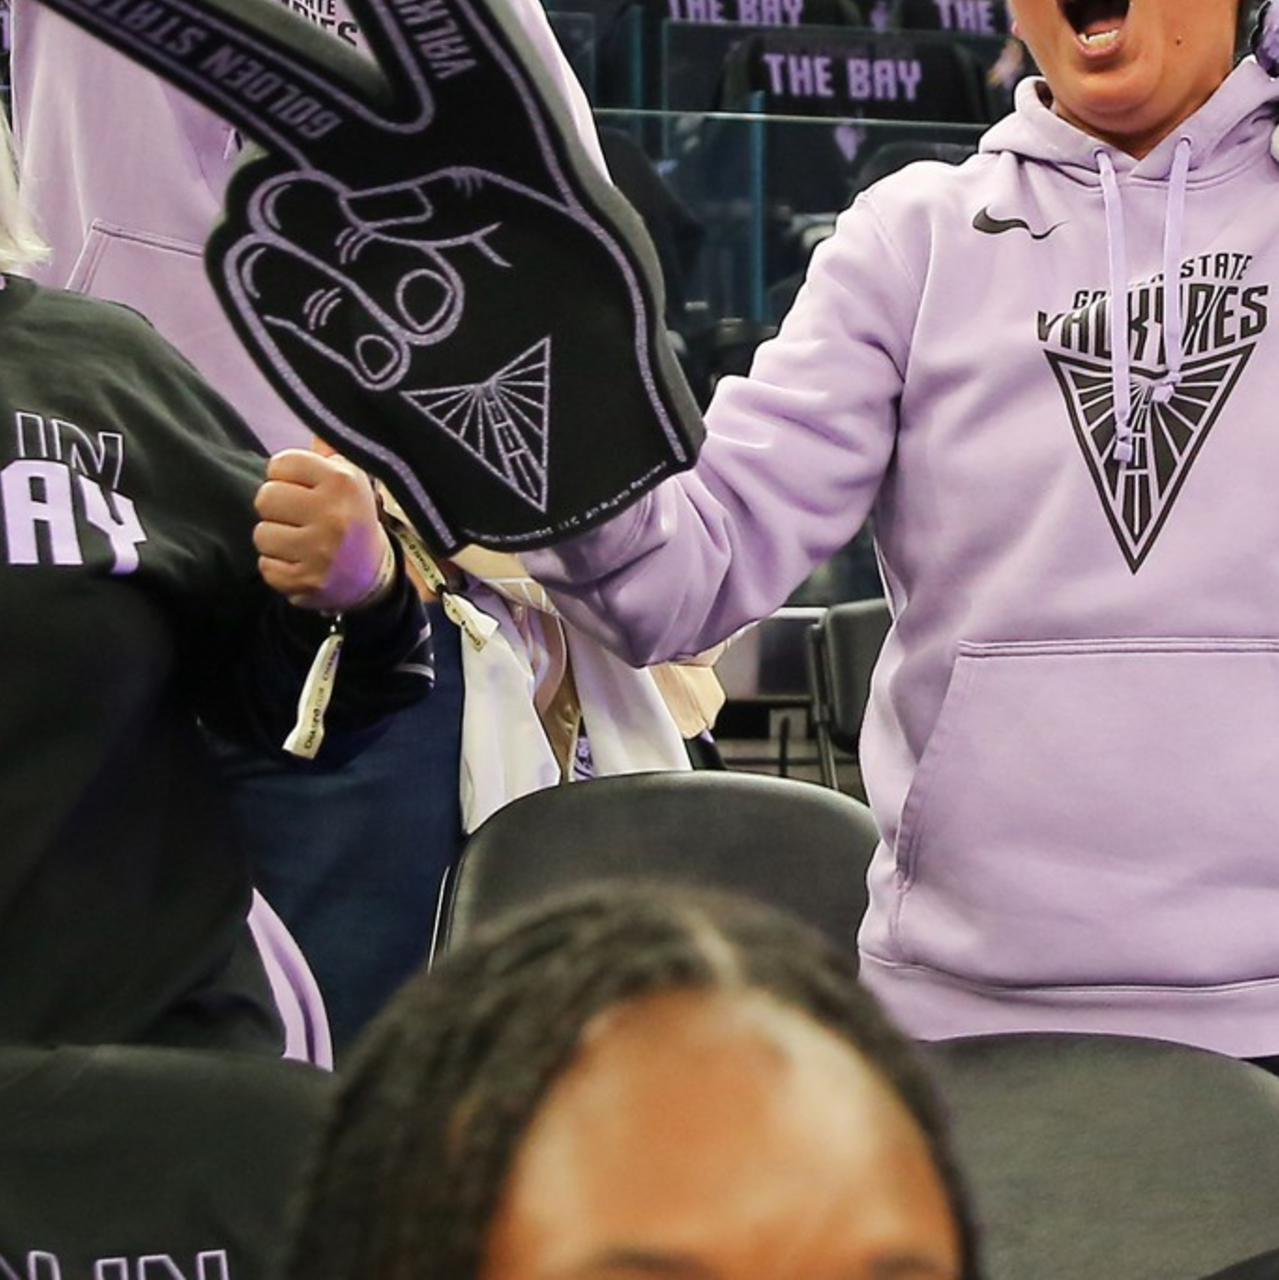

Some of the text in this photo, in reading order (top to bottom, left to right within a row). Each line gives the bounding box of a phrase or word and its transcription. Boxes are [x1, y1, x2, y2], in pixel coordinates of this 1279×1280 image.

[199, 46, 343, 139] GOLDEN
[763, 53, 922, 101] THE BAY
[1180, 252, 1253, 281] STATE
[16, 410, 124, 491] IN
